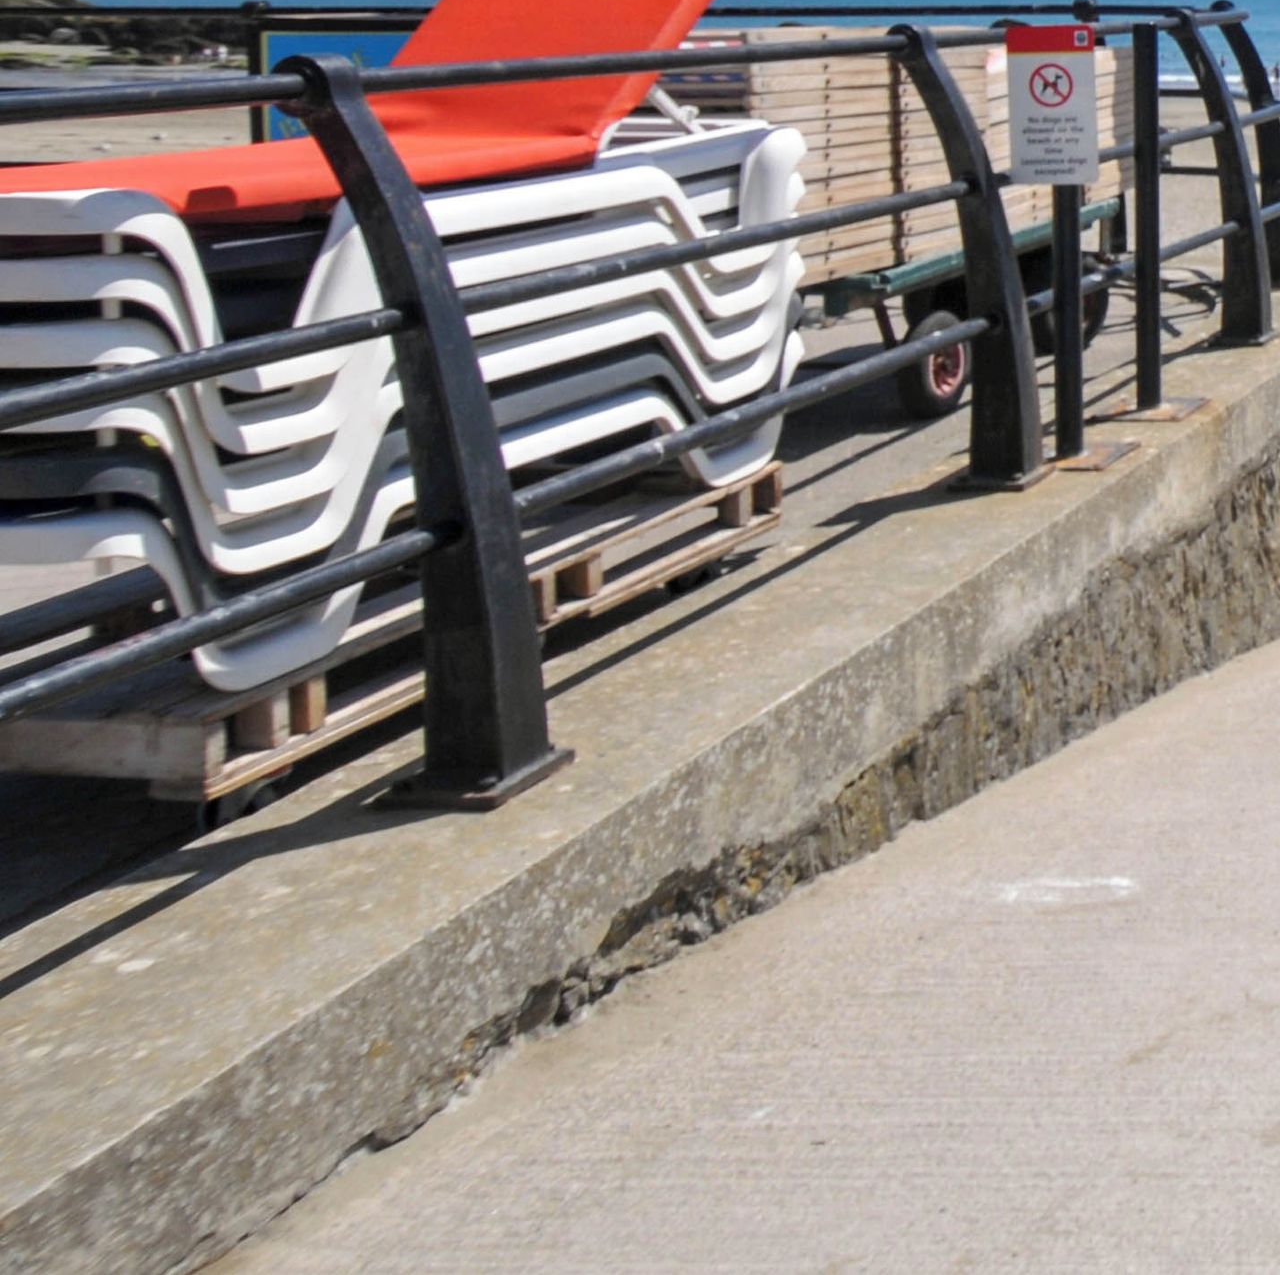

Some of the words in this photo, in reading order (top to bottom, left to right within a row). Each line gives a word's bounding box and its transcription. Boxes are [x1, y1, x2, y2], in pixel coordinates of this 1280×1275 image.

[1027, 116, 1040, 124] No
[1042, 115, 1062, 125] dogs
[1064, 116, 1078, 124] are
[1022, 126, 1055, 134] allowed
[1070, 125, 1084, 133] the
[1026, 136, 1051, 144] beach
[1053, 136, 1063, 144] at
[1064, 136, 1080, 145] any
[1044, 147, 1063, 155] time
[1066, 156, 1088, 166] dogs
